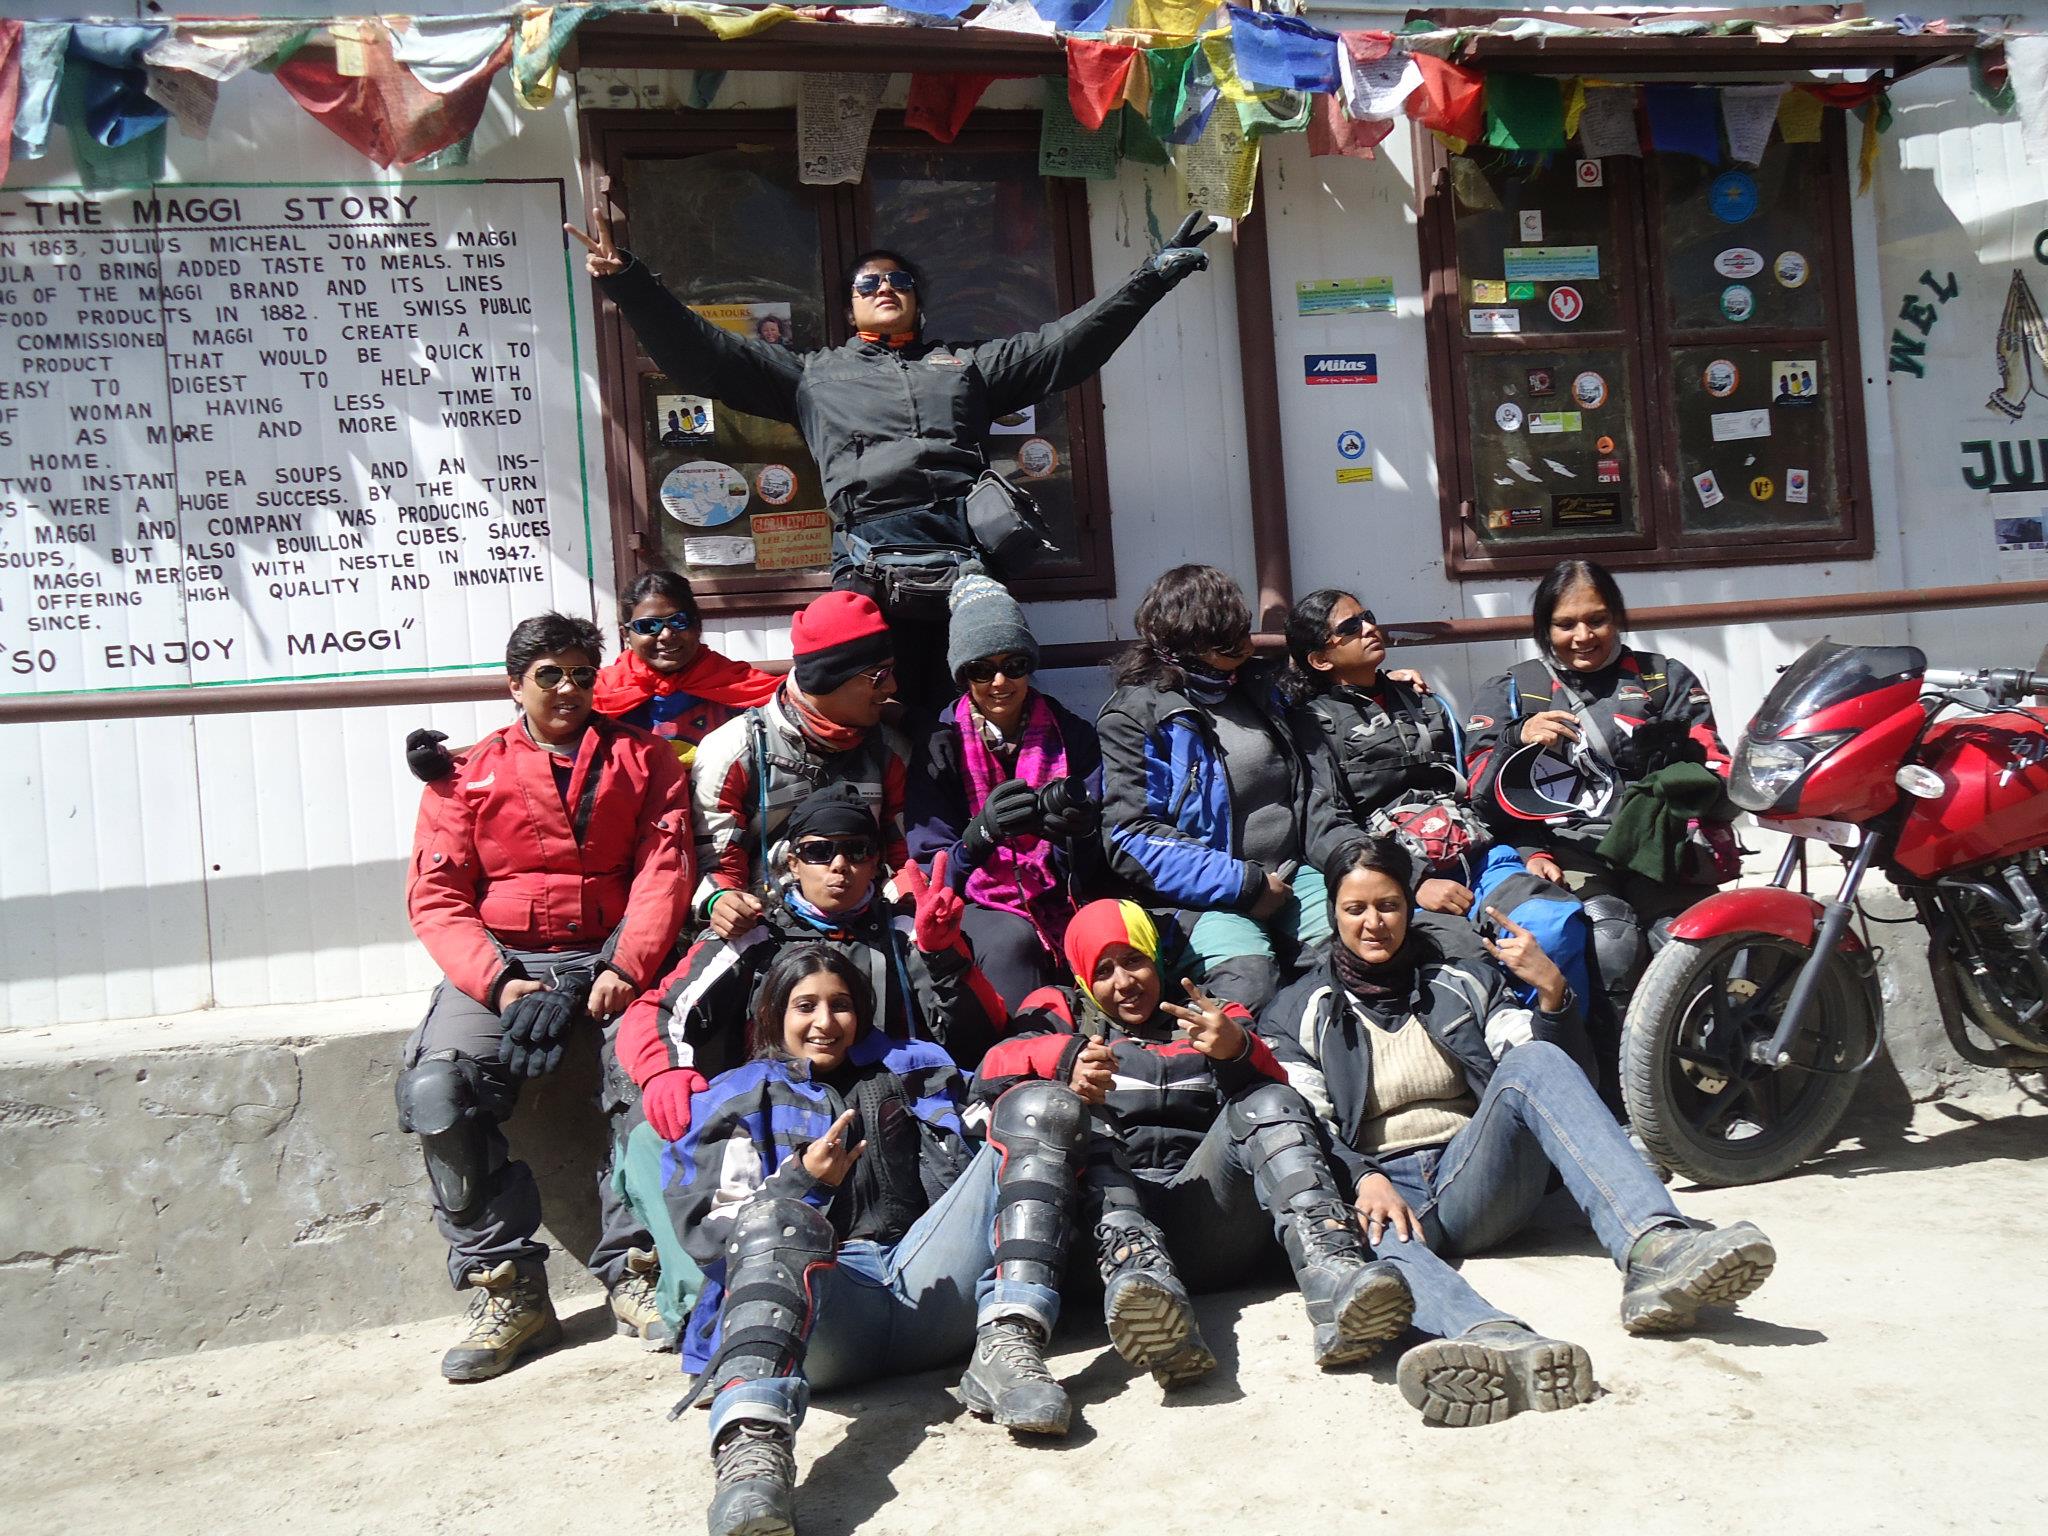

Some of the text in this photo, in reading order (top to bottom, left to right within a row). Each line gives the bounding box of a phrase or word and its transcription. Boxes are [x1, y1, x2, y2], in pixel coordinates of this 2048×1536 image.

[133, 197, 241, 224] MAGGI
[284, 196, 417, 221] STORY
[100, 237, 181, 255] JULIUS
[210, 235, 306, 252] MICHEAL
[328, 232, 437, 250] JOHANNES
[457, 231, 516, 246] MAGGI
[53, 264, 81, 281] TO
[99, 260, 159, 280] BRING
[177, 260, 241, 277] ADDED
[261, 257, 324, 274] TASTE
[341, 256, 366, 271] TO
[381, 254, 451, 270] MEALS.
[462, 254, 505, 268] THIS
[33, 287, 57, 303] OF
[77, 287, 118, 302] THE
[139, 282, 202, 302] MAGGI
[230, 281, 298, 299] BRAND
[327, 279, 366, 296] AND
[391, 277, 424, 294] ITS
[447, 275, 502, 292] LINES
[77, 307, 192, 324] PRODUCTS
[216, 307, 238, 322] IN
[338, 302, 379, 318] THE
[403, 299, 466, 316] SWISS
[480, 298, 531, 314] PUBLIC
[17, 332, 166, 350] COMMISSIONED
[193, 328, 253, 345] MAGGI
[283, 327, 308, 341] TO
[342, 324, 419, 340] CREATE
[22, 342, 530, 373] PRODUCT THAT WOULD BE QUICK TO
[1313, 359, 1367, 372] Mitas
[91, 379, 120, 397] TO
[171, 375, 247, 394] DIGEST
[300, 371, 328, 389] TO
[381, 368, 430, 386] HELP
[471, 366, 520, 382] WITH
[69, 403, 152, 421] WOMAN
[206, 398, 283, 416] HAVING
[334, 394, 385, 411] LESS
[438, 389, 494, 406] TIME
[510, 387, 531, 401] TO
[76, 428, 107, 445] AS
[147, 424, 213, 444] MORE
[258, 421, 302, 438] AND
[339, 416, 398, 433] MORE
[442, 409, 521, 428] WORKED
[0, 477, 52, 494] TWO
[83, 473, 175, 492] INSTANT
[205, 470, 247, 487] PEA
[275, 466, 342, 483] SOUPS
[371, 461, 408, 479] AND
[438, 458, 465, 475] AN
[48, 498, 110, 516] WERE
[180, 494, 229, 510] HUGE
[256, 489, 348, 506] SUCCESS.
[369, 485, 391, 501] BY
[415, 481, 453, 498] THE
[479, 476, 537, 492] TURN
[35, 498, 546, 544] MAGGI AND COMPANY WAS PRODUCING NOT
[111, 547, 153, 564] BUT
[187, 542, 235, 560] ALSO
[276, 533, 363, 554] BOUILLON
[489, 521, 550, 539] SAUCES
[34, 546, 535, 589] MAGGI MERGED WITH NESTLE IN 1947.
[38, 566, 544, 610] OFFERING HIGH QUALITY AND INNOVATIVE
[27, 615, 101, 631] SINCE.
[105, 637, 233, 669] ENJOY
